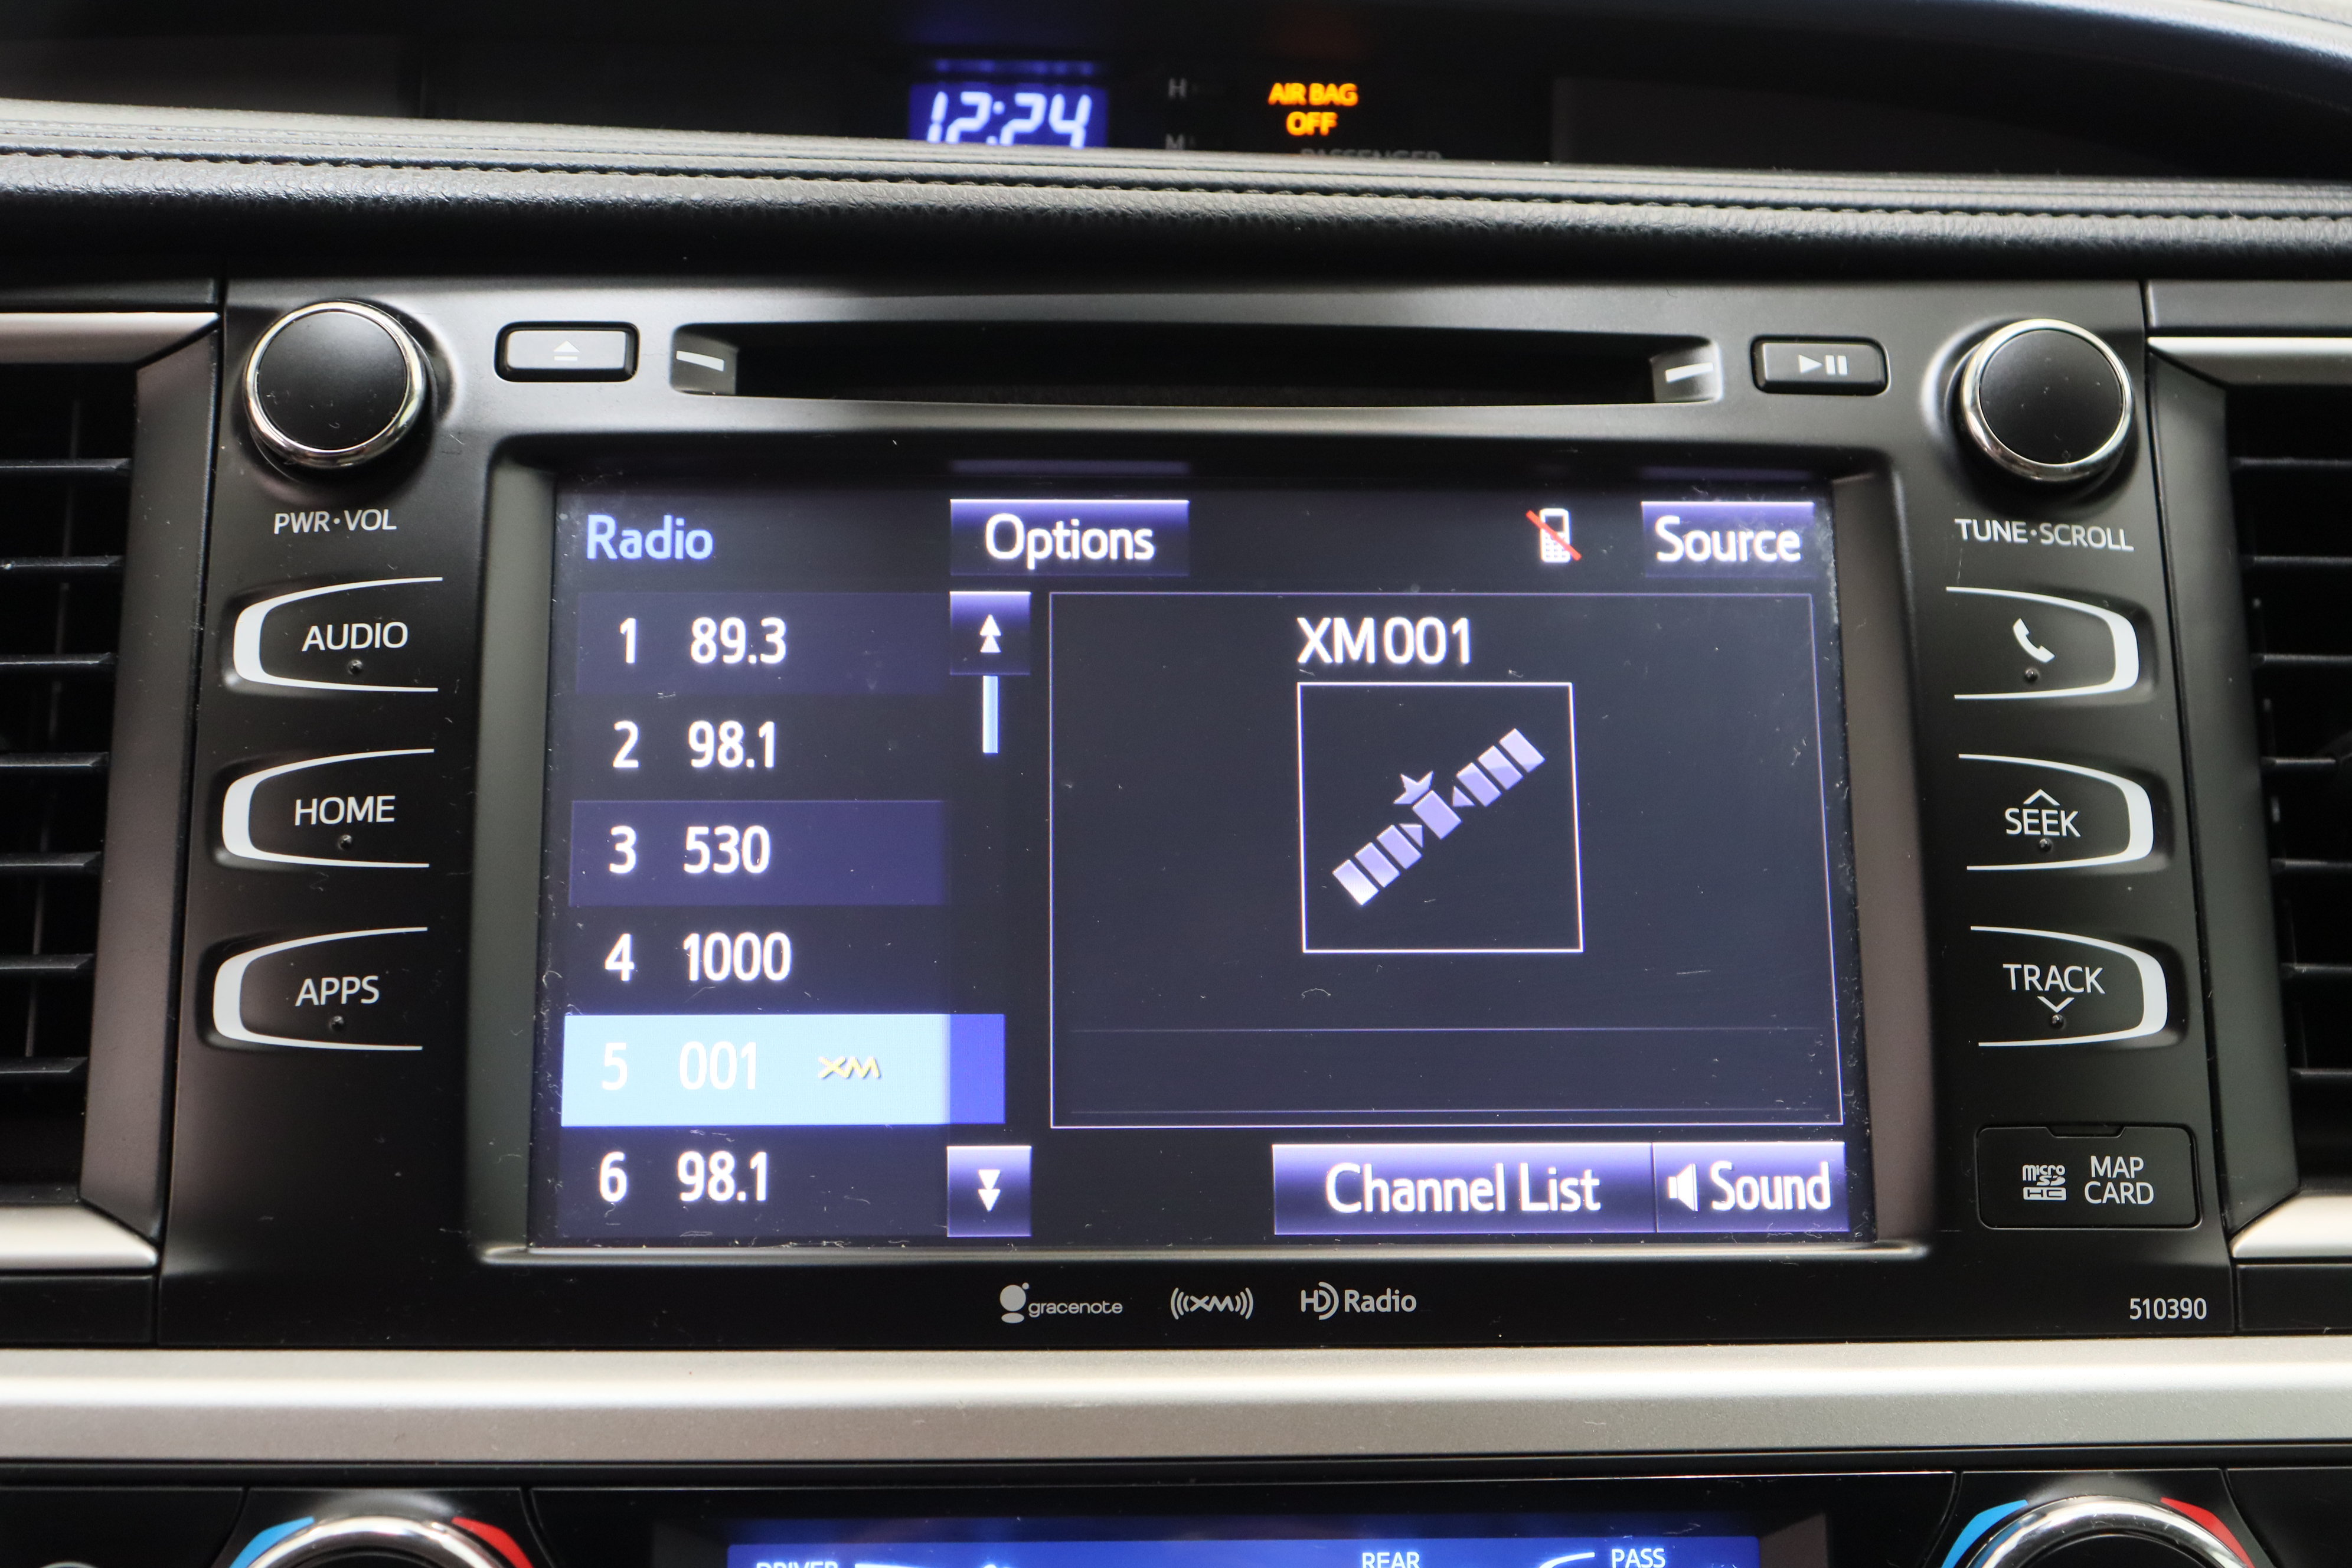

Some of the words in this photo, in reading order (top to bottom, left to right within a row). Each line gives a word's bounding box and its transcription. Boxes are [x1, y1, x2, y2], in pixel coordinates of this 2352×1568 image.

[1268, 83, 1307, 106] AIR
[1308, 83, 1358, 106] BAG
[927, 91, 1092, 149] 12:24
[1286, 111, 1338, 136] OFF
[586, 513, 715, 561] Radio
[985, 513, 1155, 570] Options
[1655, 515, 1802, 562] Source
[302, 621, 408, 652] AUDIO
[619, 618, 638, 664] 1
[690, 616, 788, 665] 89.3
[612, 720, 640, 769] 2
[688, 720, 776, 769] 98.1
[295, 795, 396, 826] HOME
[2005, 808, 2081, 837] SEEK
[609, 825, 638, 875] 3
[684, 825, 772, 875] 530
[605, 933, 636, 982] 4
[683, 932, 793, 982] 1000
[295, 975, 380, 1007] APPS
[2003, 963, 2105, 994] TRACK
[601, 1041, 628, 1091] 5
[679, 1040, 757, 1090] 001
[818, 1056, 881, 1079] XM
[599, 1151, 628, 1202] 6
[677, 1151, 769, 1203] 98.1
[2022, 1164, 2066, 1181] micro
[2090, 1155, 2144, 1178] MAP
[1325, 1163, 1505, 1213] Channel
[1520, 1162, 1601, 1212] List
[1710, 1161, 1831, 1211] Sound
[2023, 1187, 2067, 1201] HC
[2085, 1181, 2154, 1204] CARD
[1028, 1301, 1123, 1318] gracenote
[1301, 1281, 1340, 1320] HD
[1344, 1288, 1417, 1313] Radio
[2129, 1298, 2207, 1320] 510390
[1361, 1552, 1420, 1568] REAR
[1611, 1548, 1666, 1568] PASS
